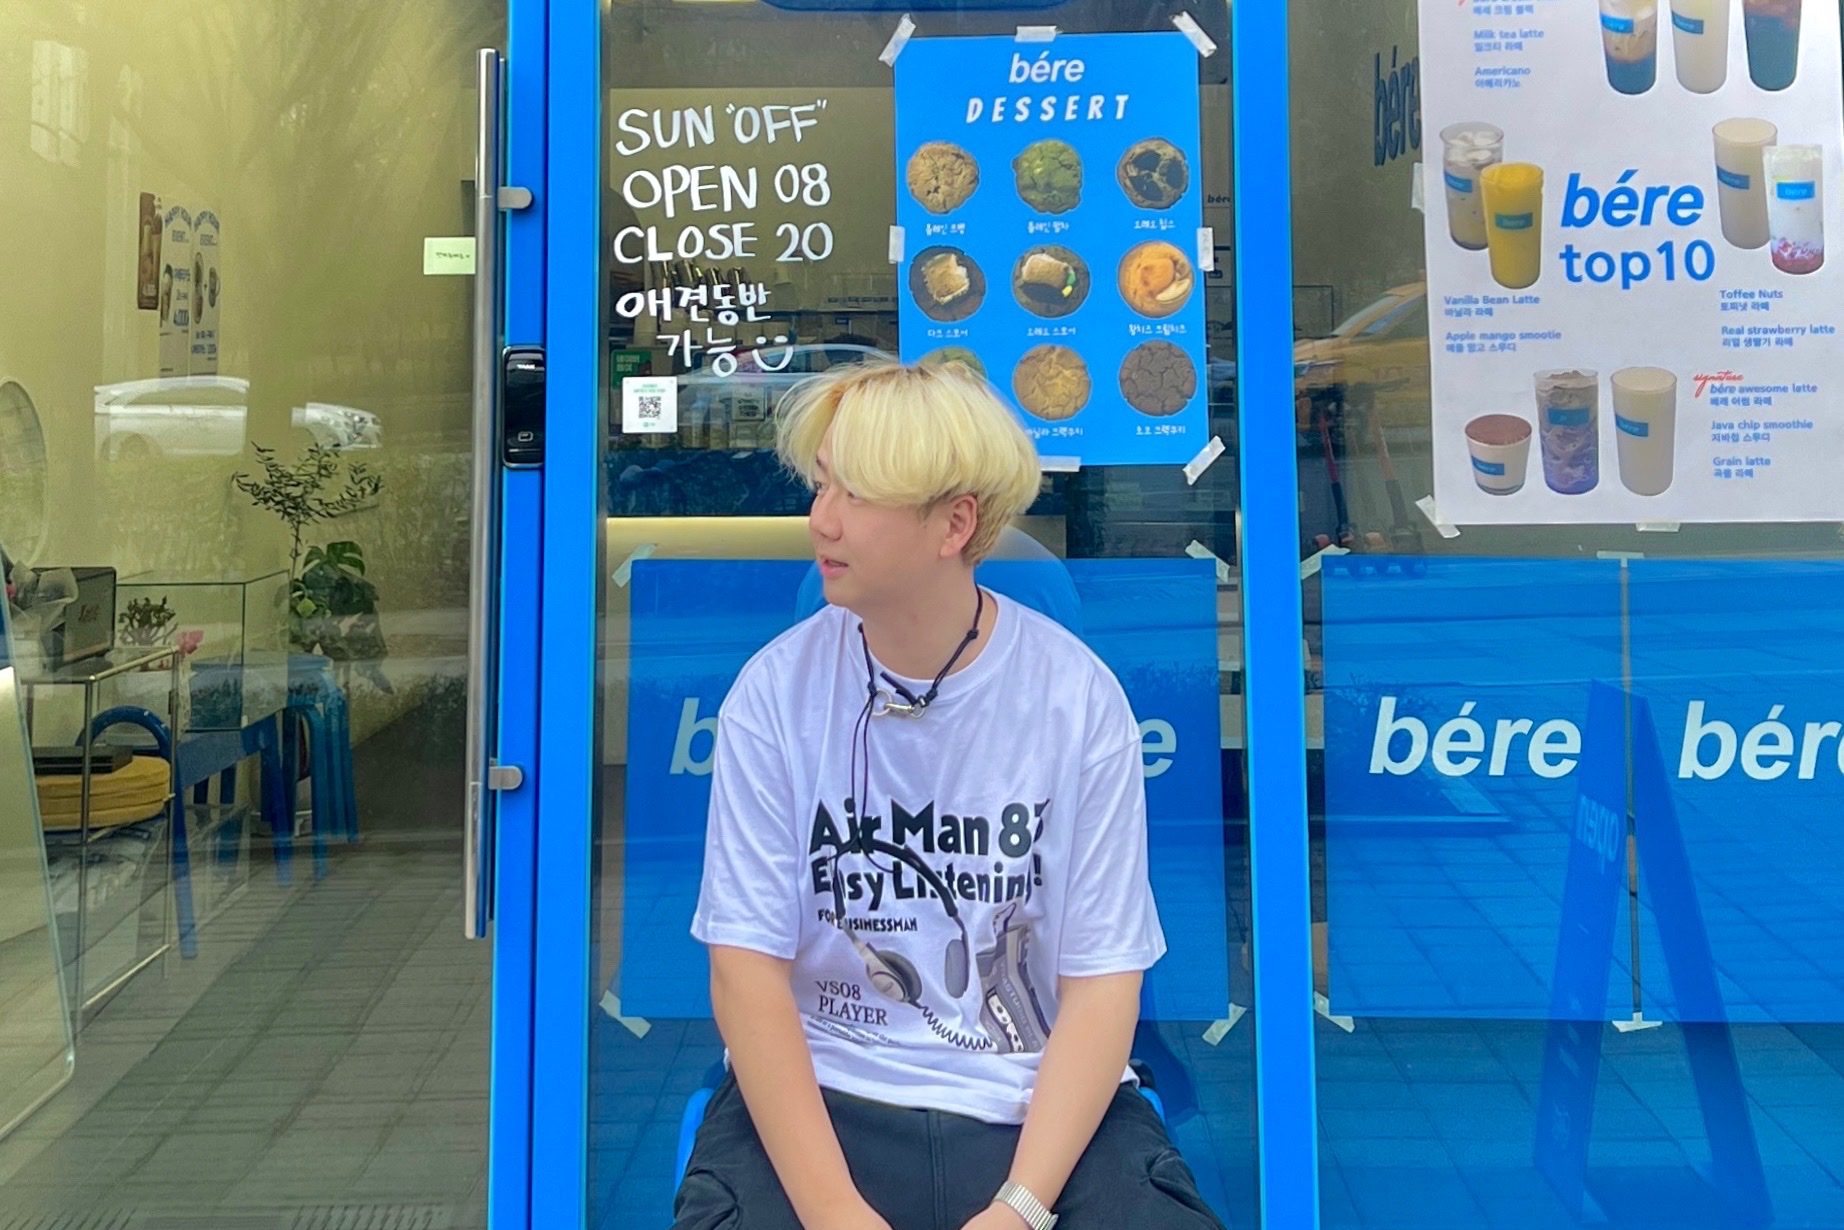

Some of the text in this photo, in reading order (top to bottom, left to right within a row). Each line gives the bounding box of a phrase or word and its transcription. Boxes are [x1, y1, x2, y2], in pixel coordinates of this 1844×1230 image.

[1474, 29, 1544, 39] Milk tea latte
[1009, 51, 1085, 83] bére
[1475, 66, 1531, 75] Americano
[1475, 79, 1520, 88] 아메리카노
[966, 95, 1130, 123] DESSERT
[616, 105, 715, 156] SUN
[623, 163, 831, 218] OPEN 08
[1560, 169, 1704, 228] bére
[614, 222, 834, 264] CLOSE 20
[1559, 239, 1715, 290] top10
[616, 283, 772, 325] 애견동반
[1444, 295, 1540, 305] Vanilla Bean Latte
[1720, 289, 1783, 299] Toffee Nuts
[1446, 331, 1476, 341] Apple
[1480, 332, 1516, 341] mango
[1721, 324, 1835, 336] Real strawberry latte
[657, 327, 737, 377] 가능
[1738, 384, 1789, 393] awesome
[1792, 383, 1818, 393] latte
[1711, 419, 1813, 431] Java chip smoothie
[1713, 456, 1771, 466] Grain latte
[1369, 697, 1581, 778] bére
[1678, 700, 1844, 780] bér
[809, 797, 882, 855] Air
[891, 798, 989, 856] Man
[811, 852, 1042, 911] Esy Litenin!
[819, 994, 888, 1027] PLAYER
